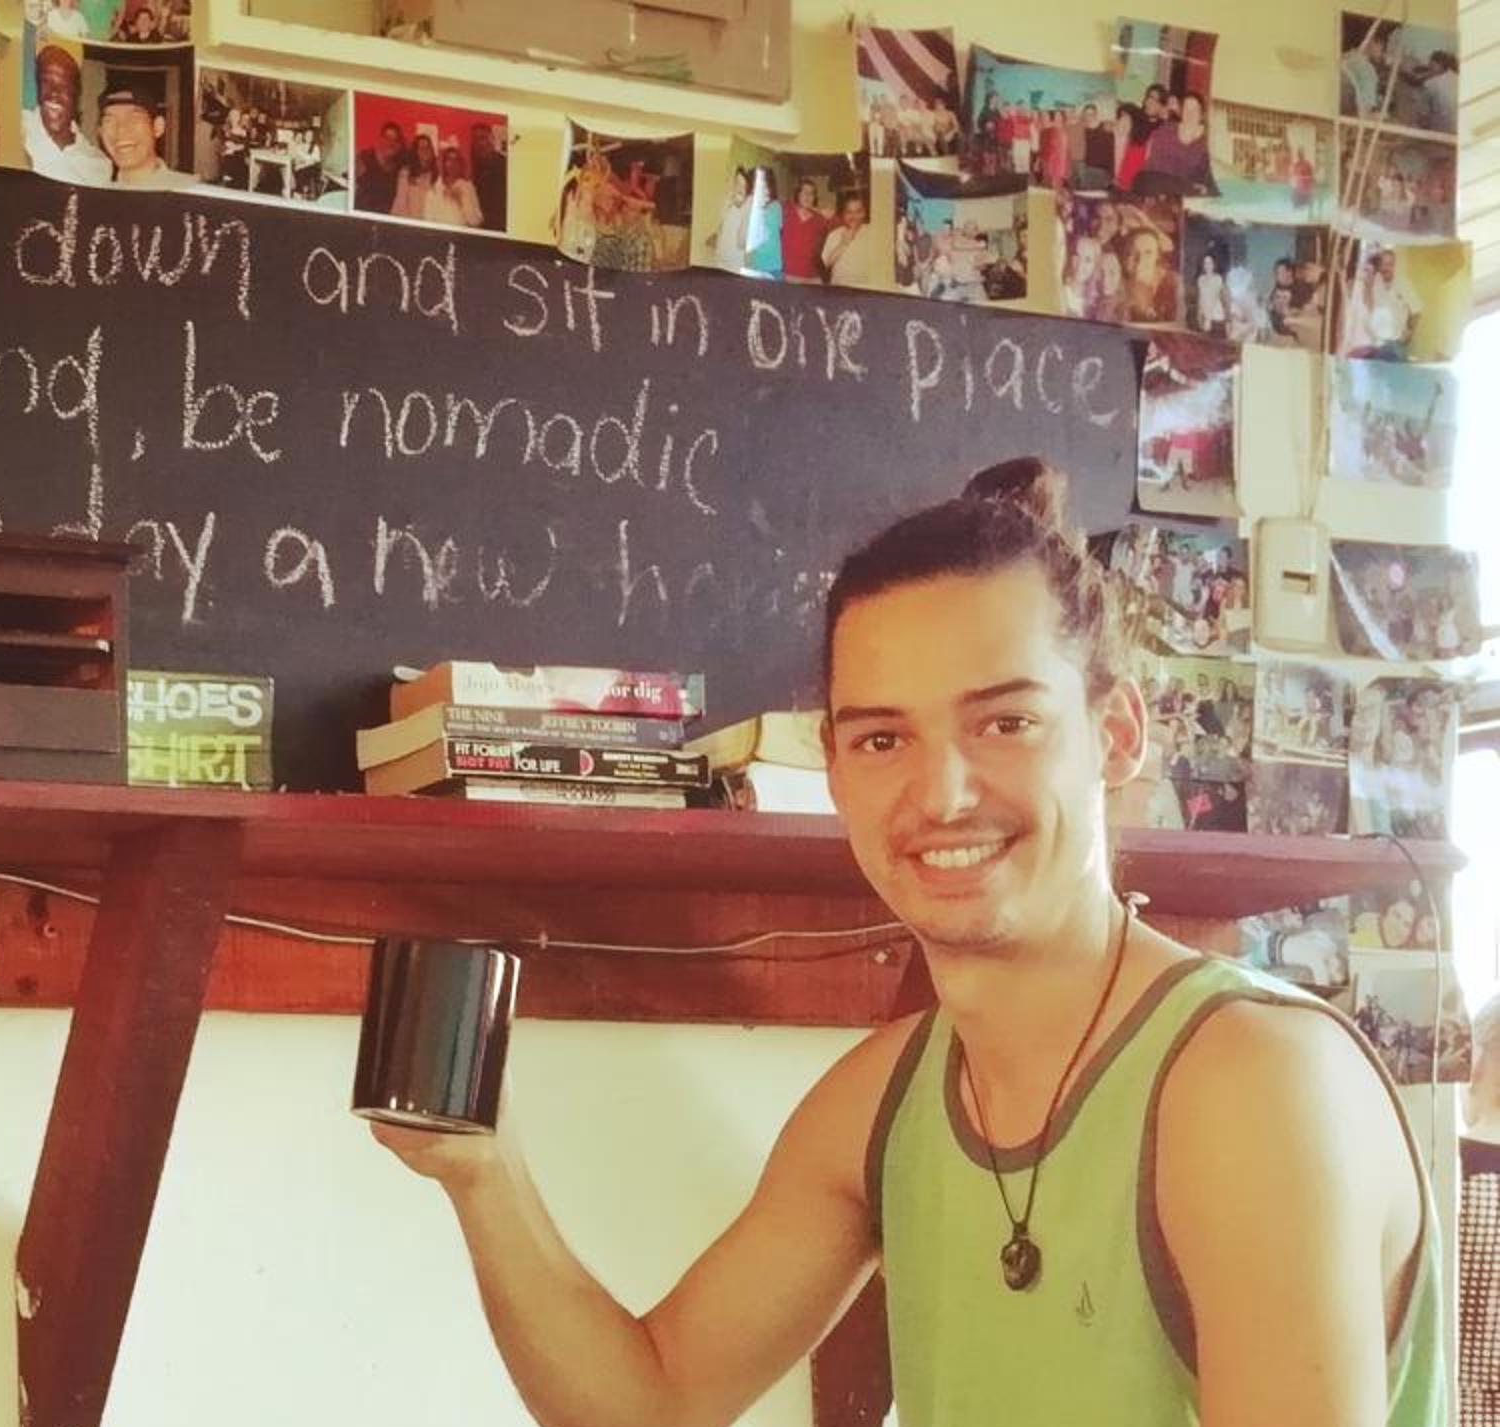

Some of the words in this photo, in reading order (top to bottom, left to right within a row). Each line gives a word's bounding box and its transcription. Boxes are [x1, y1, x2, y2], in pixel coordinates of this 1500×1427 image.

[15, 188, 252, 320] down
[302, 243, 459, 335] and
[502, 259, 616, 352] sit
[648, 280, 710, 356] in
[183, 320, 283, 464] be
[340, 378, 719, 515] nomadic
[263, 525, 335, 608] a
[373, 514, 559, 609] new
[128, 678, 264, 727] HOES
[633, 680, 663, 704] dig
